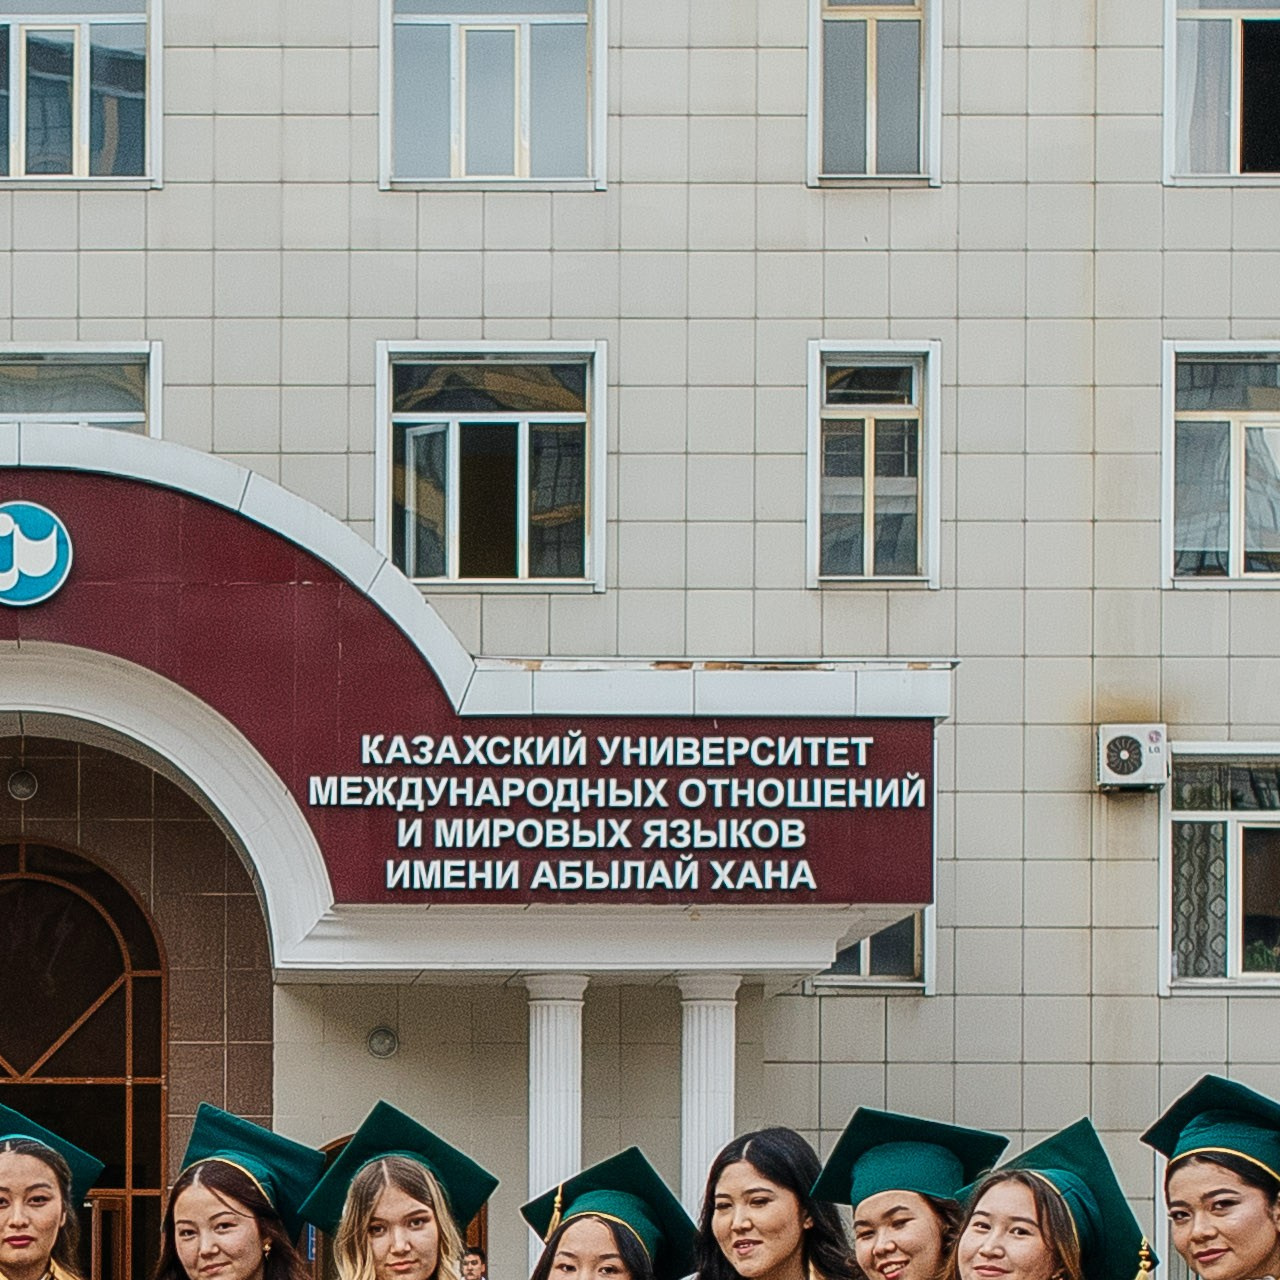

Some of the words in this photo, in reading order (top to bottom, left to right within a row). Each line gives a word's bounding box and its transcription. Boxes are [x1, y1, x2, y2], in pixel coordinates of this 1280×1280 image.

[362, 730, 587, 766] КАЗАХСКИЙ
[598, 735, 874, 766] УНИВЕРСИТЕТ
[309, 775, 669, 812] МЕЖДУНАРОДНЫХ
[678, 771, 926, 808] ОТНОШЕНИЙ
[398, 818, 423, 848] И
[435, 818, 632, 848] МИРОВЫХ
[641, 818, 806, 849] ЯЗЫКОВ
[386, 859, 519, 889] ИМЕНИ
[530, 854, 699, 890] АБЫЛАЙ
[711, 859, 817, 890] ХАНА
